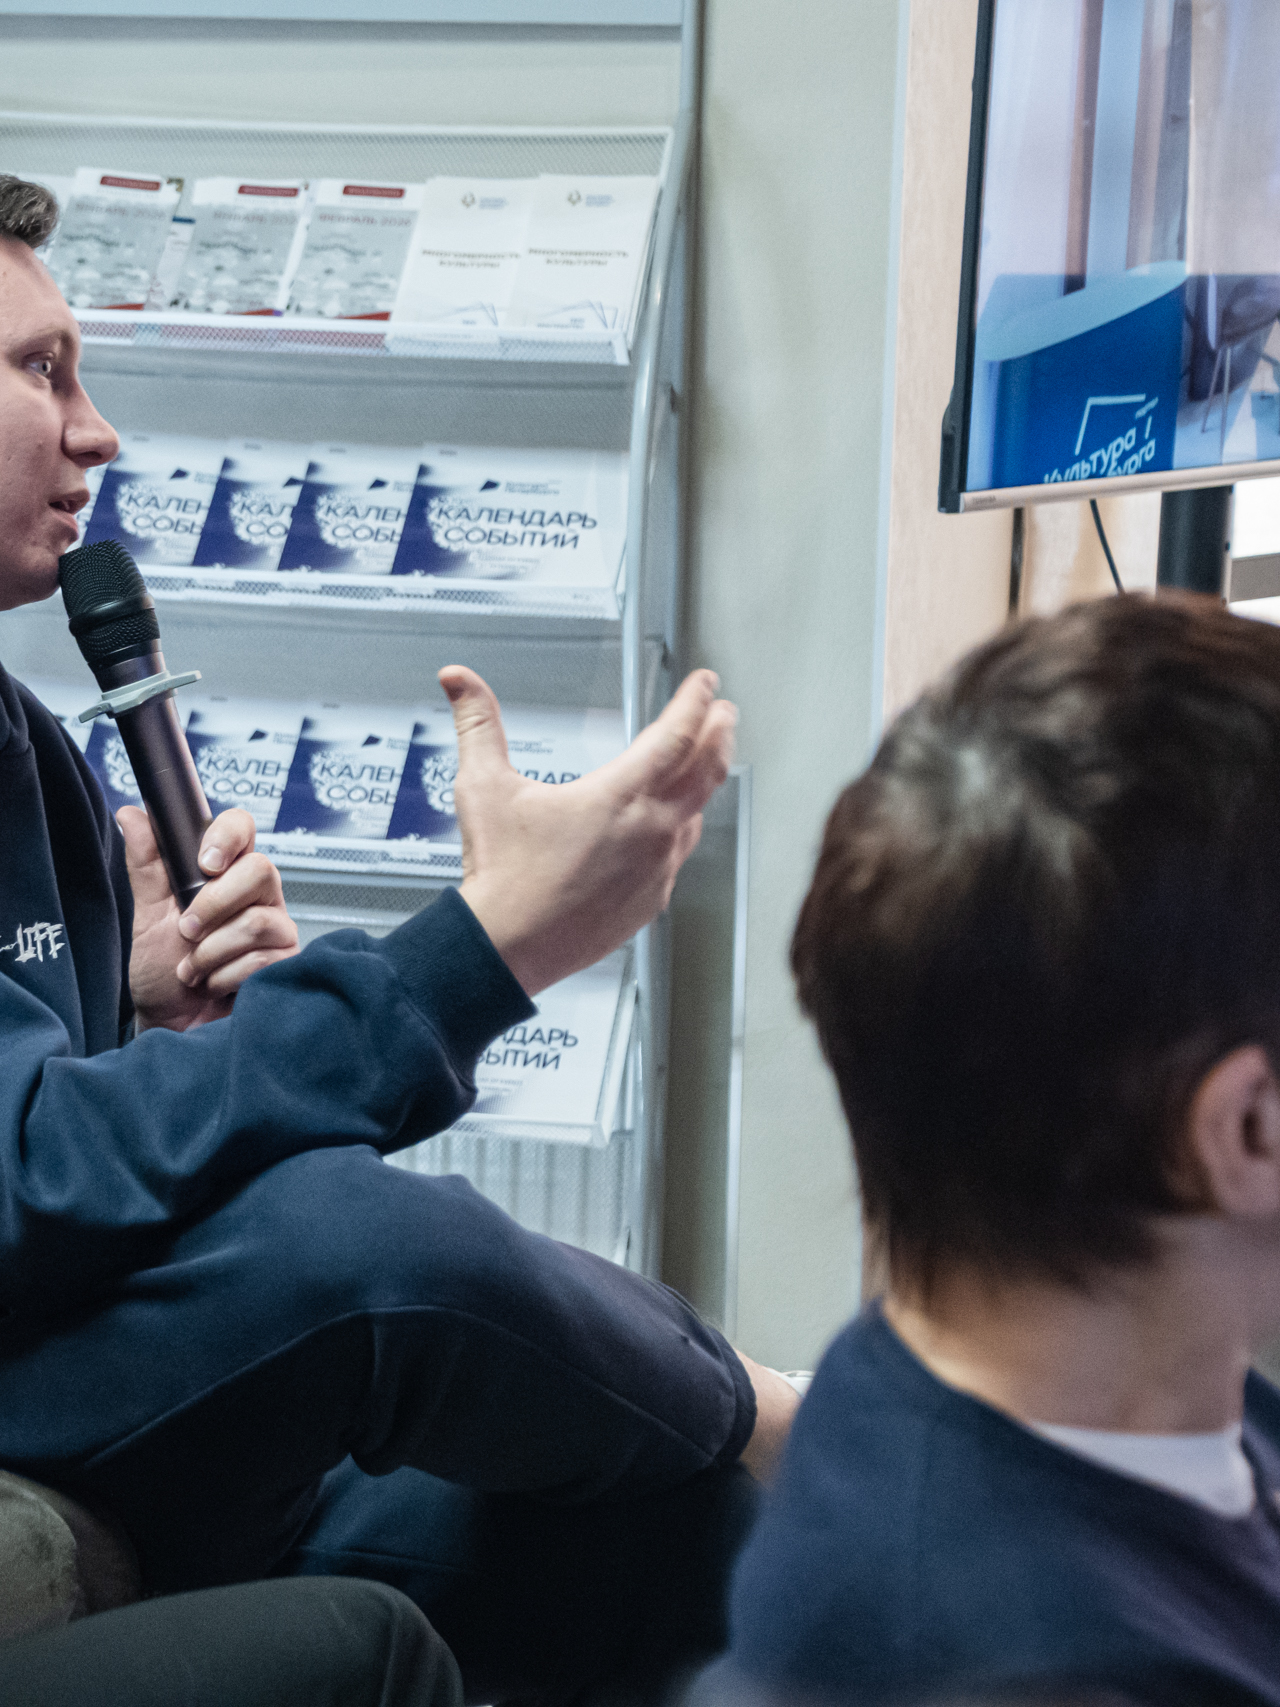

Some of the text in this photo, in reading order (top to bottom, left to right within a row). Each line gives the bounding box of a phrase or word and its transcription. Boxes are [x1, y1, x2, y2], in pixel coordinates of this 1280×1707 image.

[436, 506, 598, 530] КАЛЕНДАРЬ
[444, 526, 580, 549] СОБЫТИЙ
[503, 1024, 579, 1048] ДАРЬ
